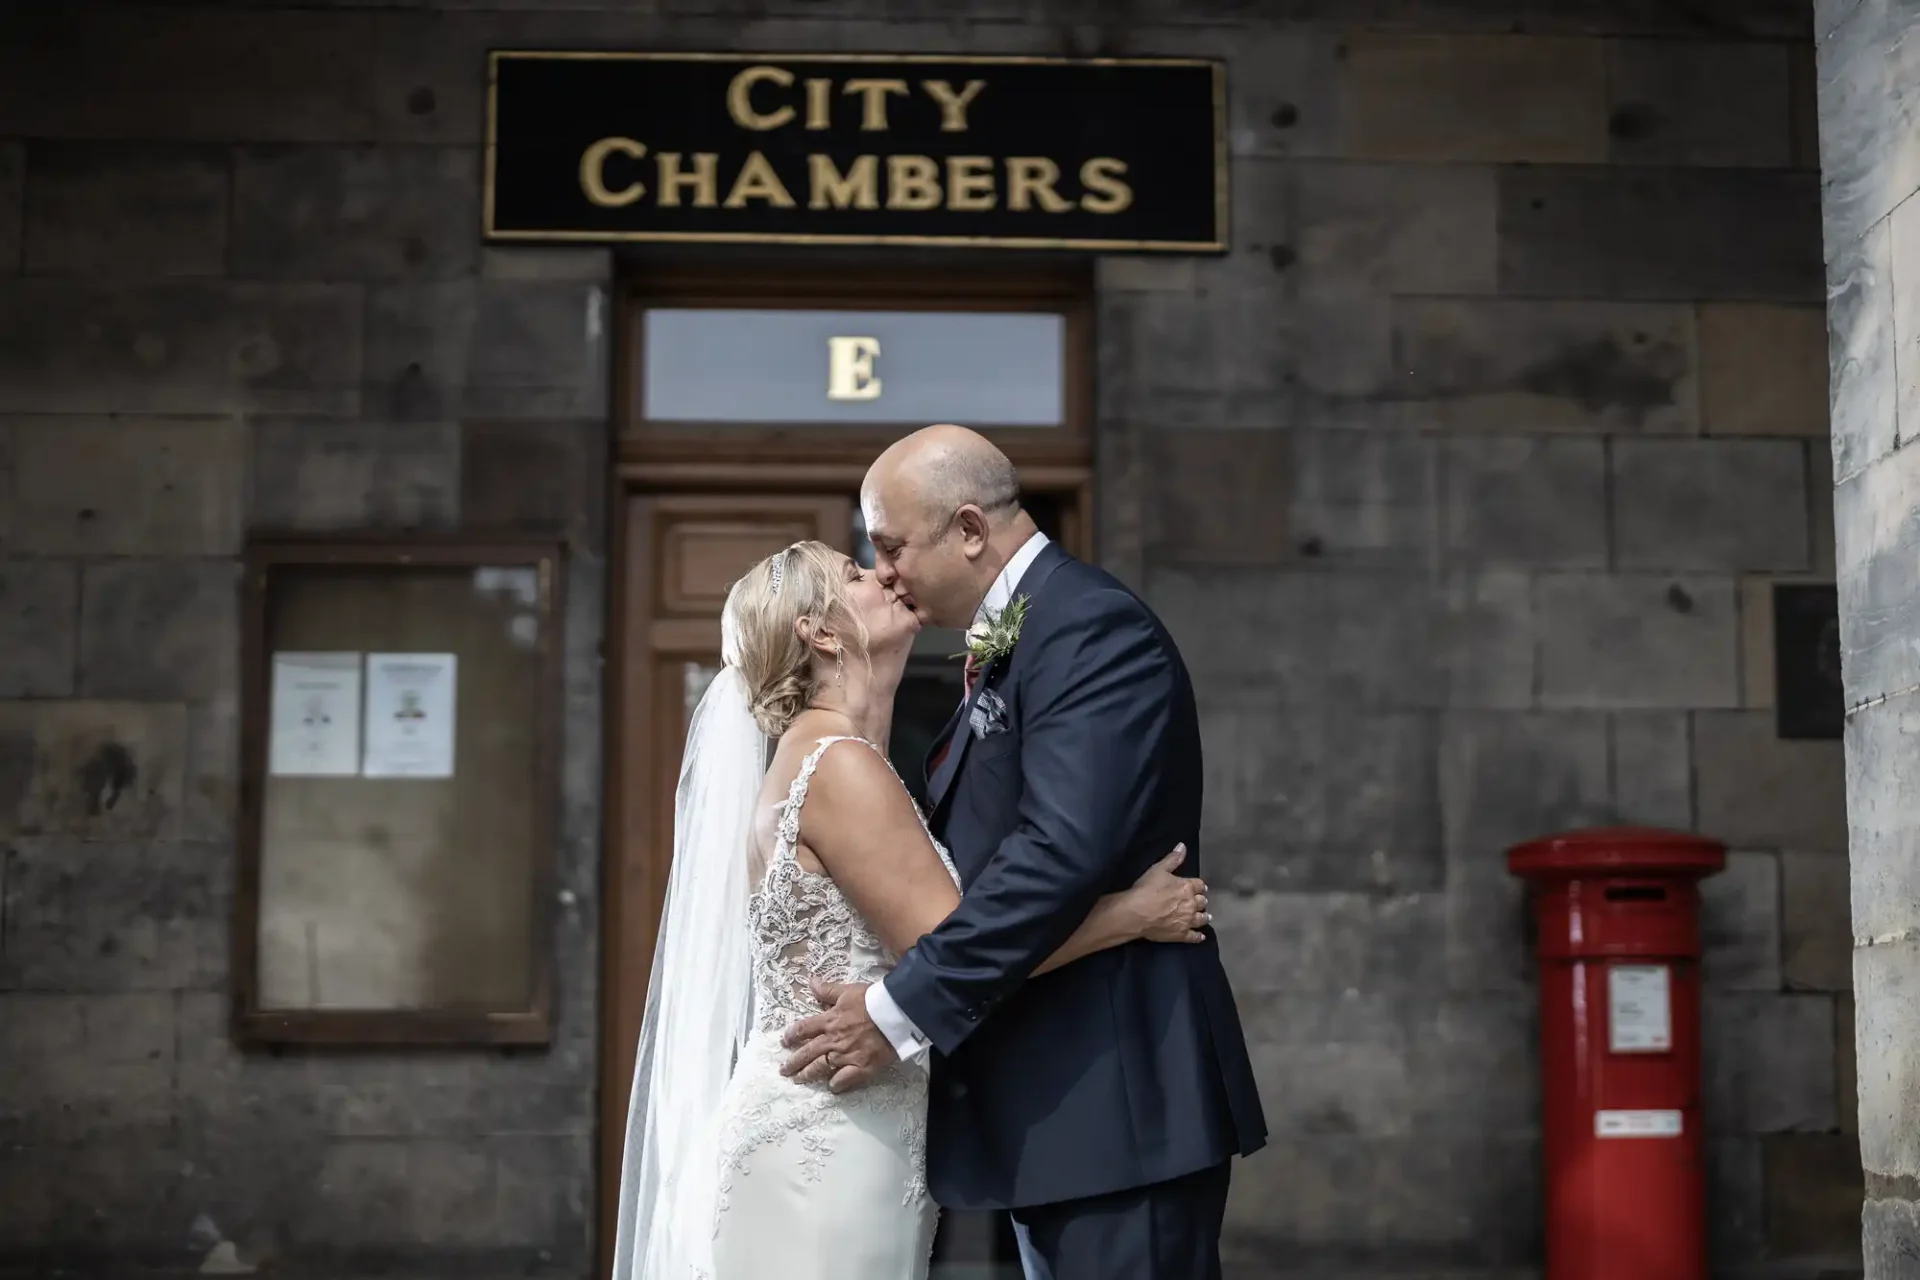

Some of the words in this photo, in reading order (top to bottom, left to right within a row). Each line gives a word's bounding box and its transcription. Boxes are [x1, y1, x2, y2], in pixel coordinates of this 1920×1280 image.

[727, 67, 986, 130] CITY
[580, 138, 1132, 212] CHAMBERS
[828, 337, 881, 399] E
